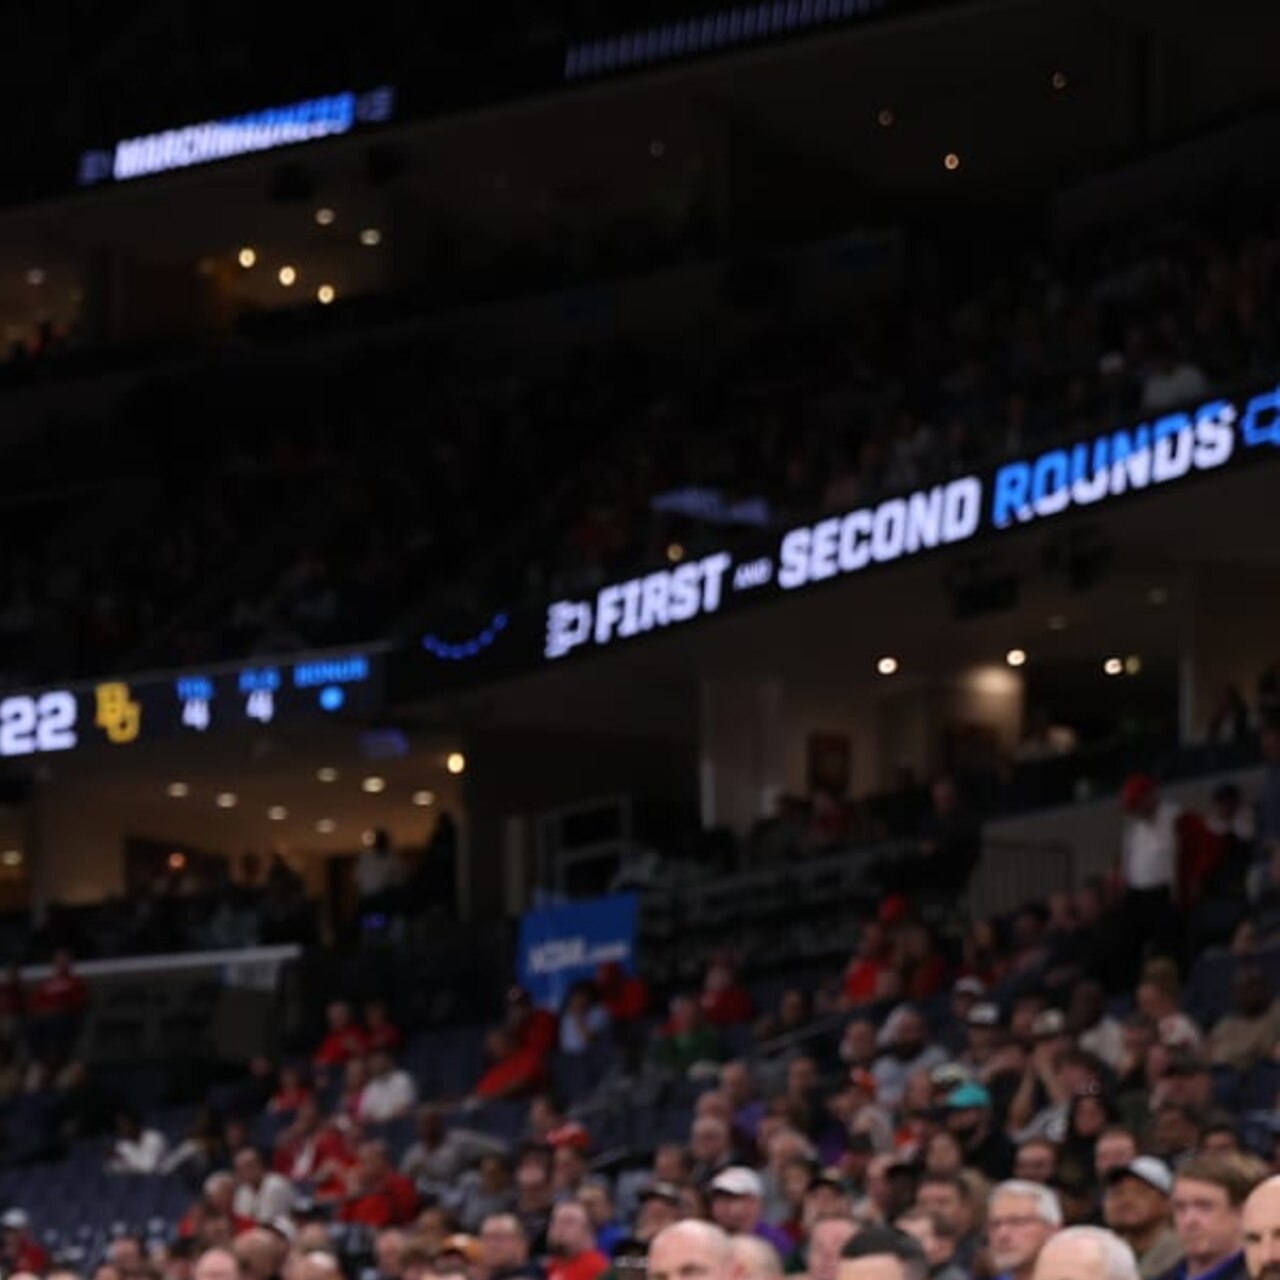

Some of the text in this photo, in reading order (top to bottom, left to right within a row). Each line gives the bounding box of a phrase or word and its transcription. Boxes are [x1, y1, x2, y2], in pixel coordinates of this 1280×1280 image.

[594, 552, 731, 645] FIRST
[778, 475, 982, 589] SECOND
[991, 400, 1236, 530] ROUNDS
